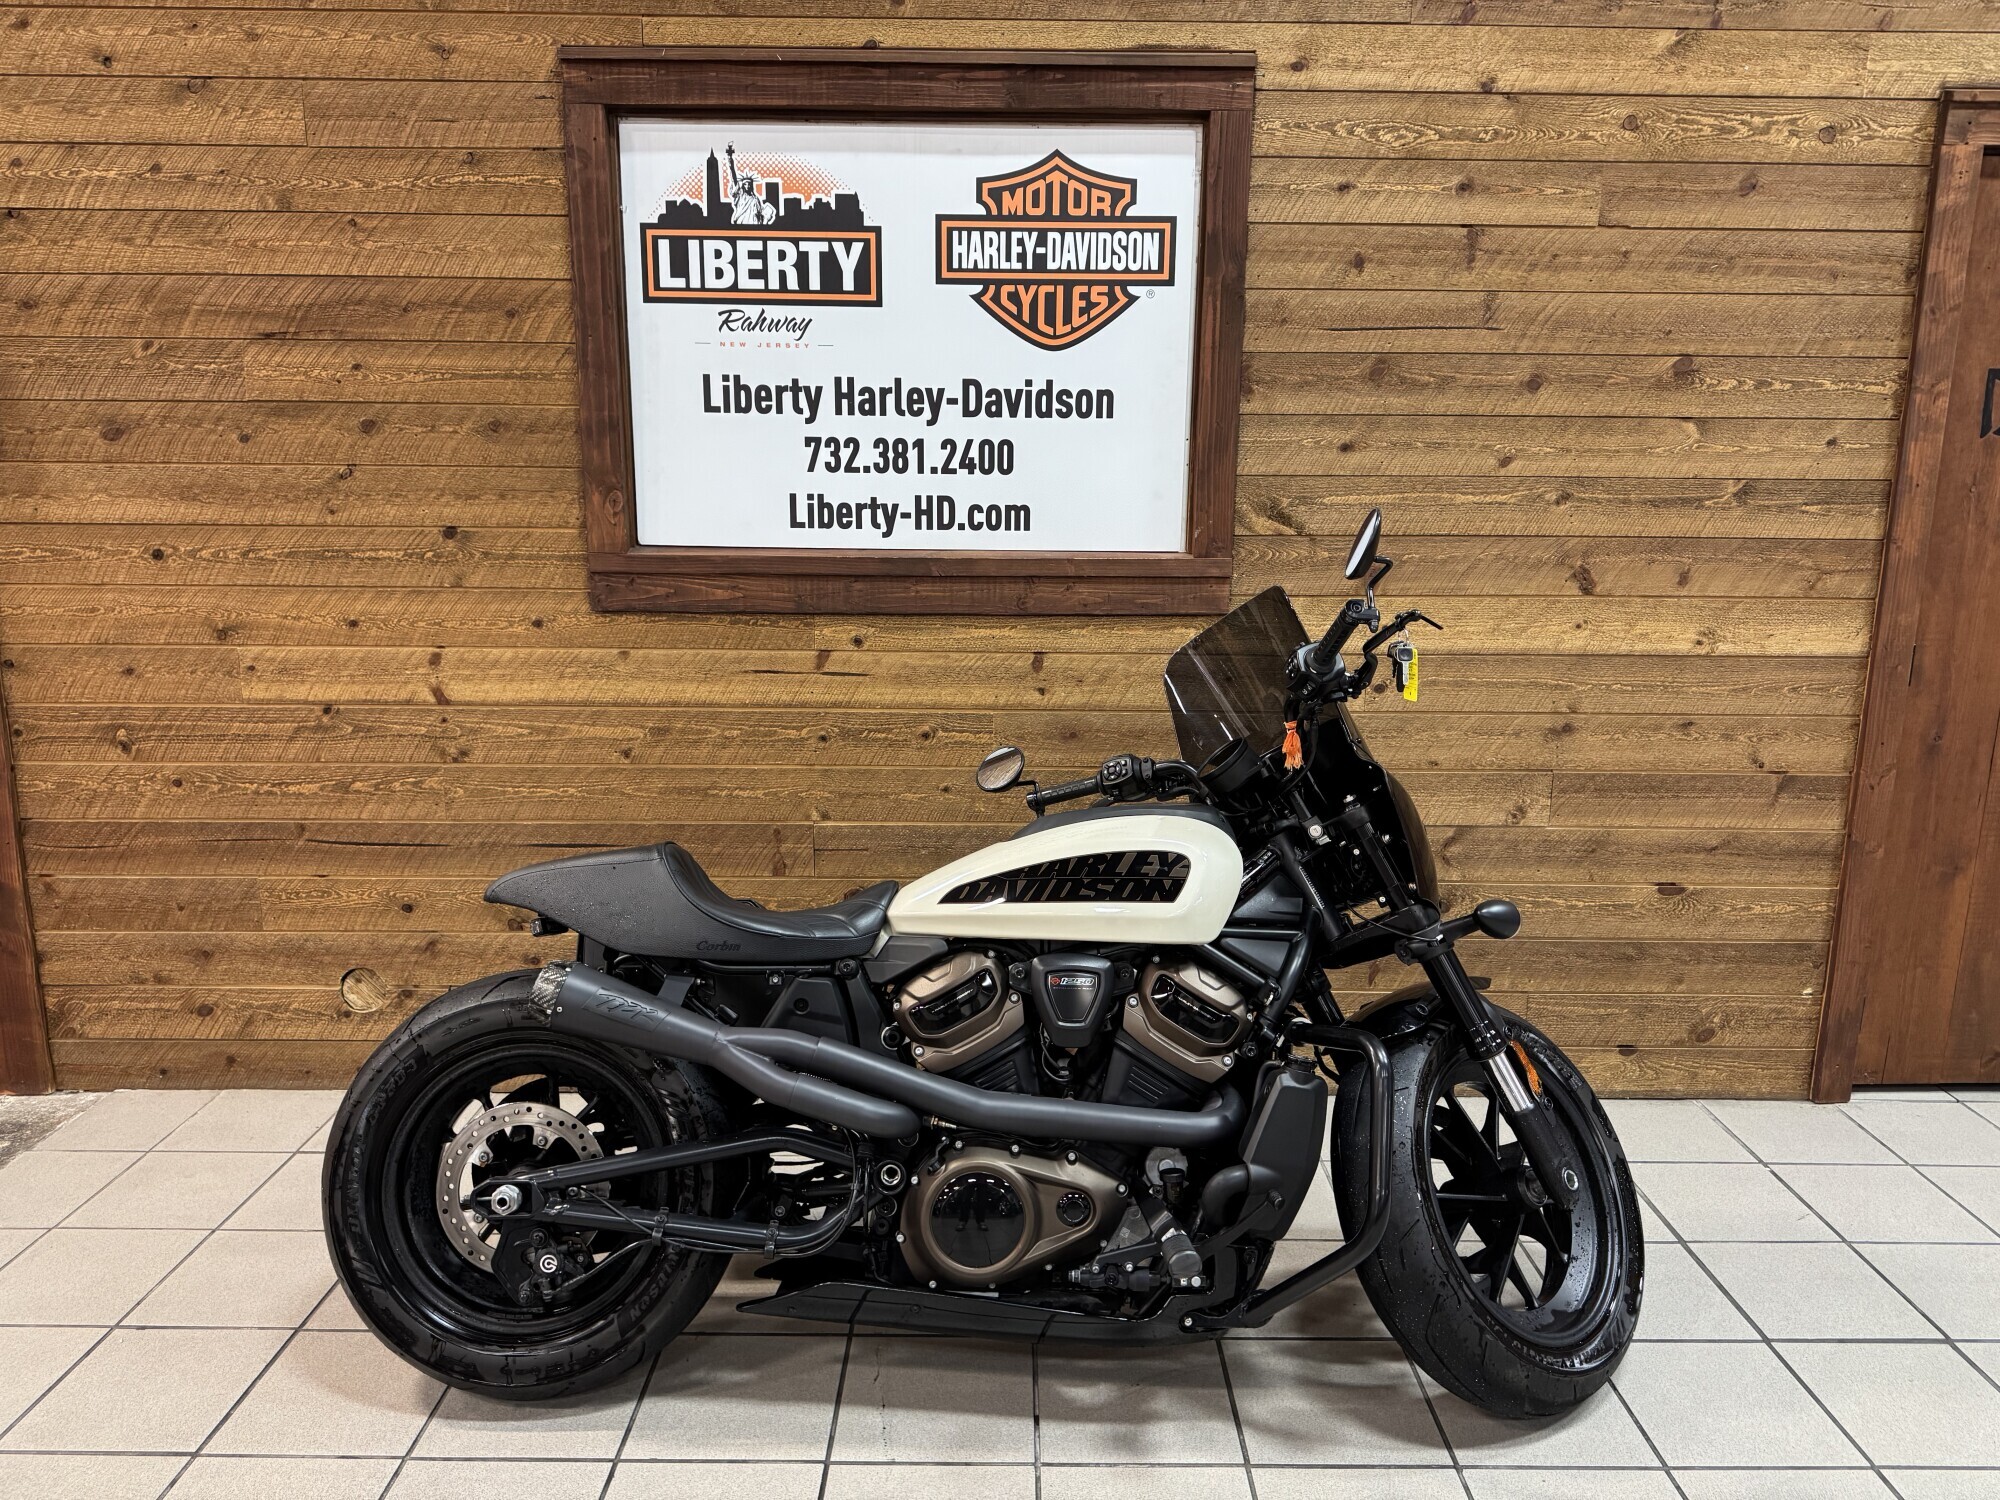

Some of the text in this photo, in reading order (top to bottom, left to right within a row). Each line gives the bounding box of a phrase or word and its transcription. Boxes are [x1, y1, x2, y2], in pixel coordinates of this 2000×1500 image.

[1002, 169, 1112, 216] MOTOR
[657, 238, 865, 291] LIBERTY
[952, 230, 1160, 271] HARLEY-DAVIDSON
[717, 307, 813, 341] Rahway
[1000, 284, 1109, 336] CYCLES
[702, 374, 1115, 426] Liberty Harley-Davidson
[804, 436, 1015, 476] 732.381.2400
[788, 492, 1031, 538] Liberty-HD.com
[938, 878, 1184, 902] DAVIDSON
[695, 939, 741, 951] Corbin
[1060, 977, 1095, 986] 1250
